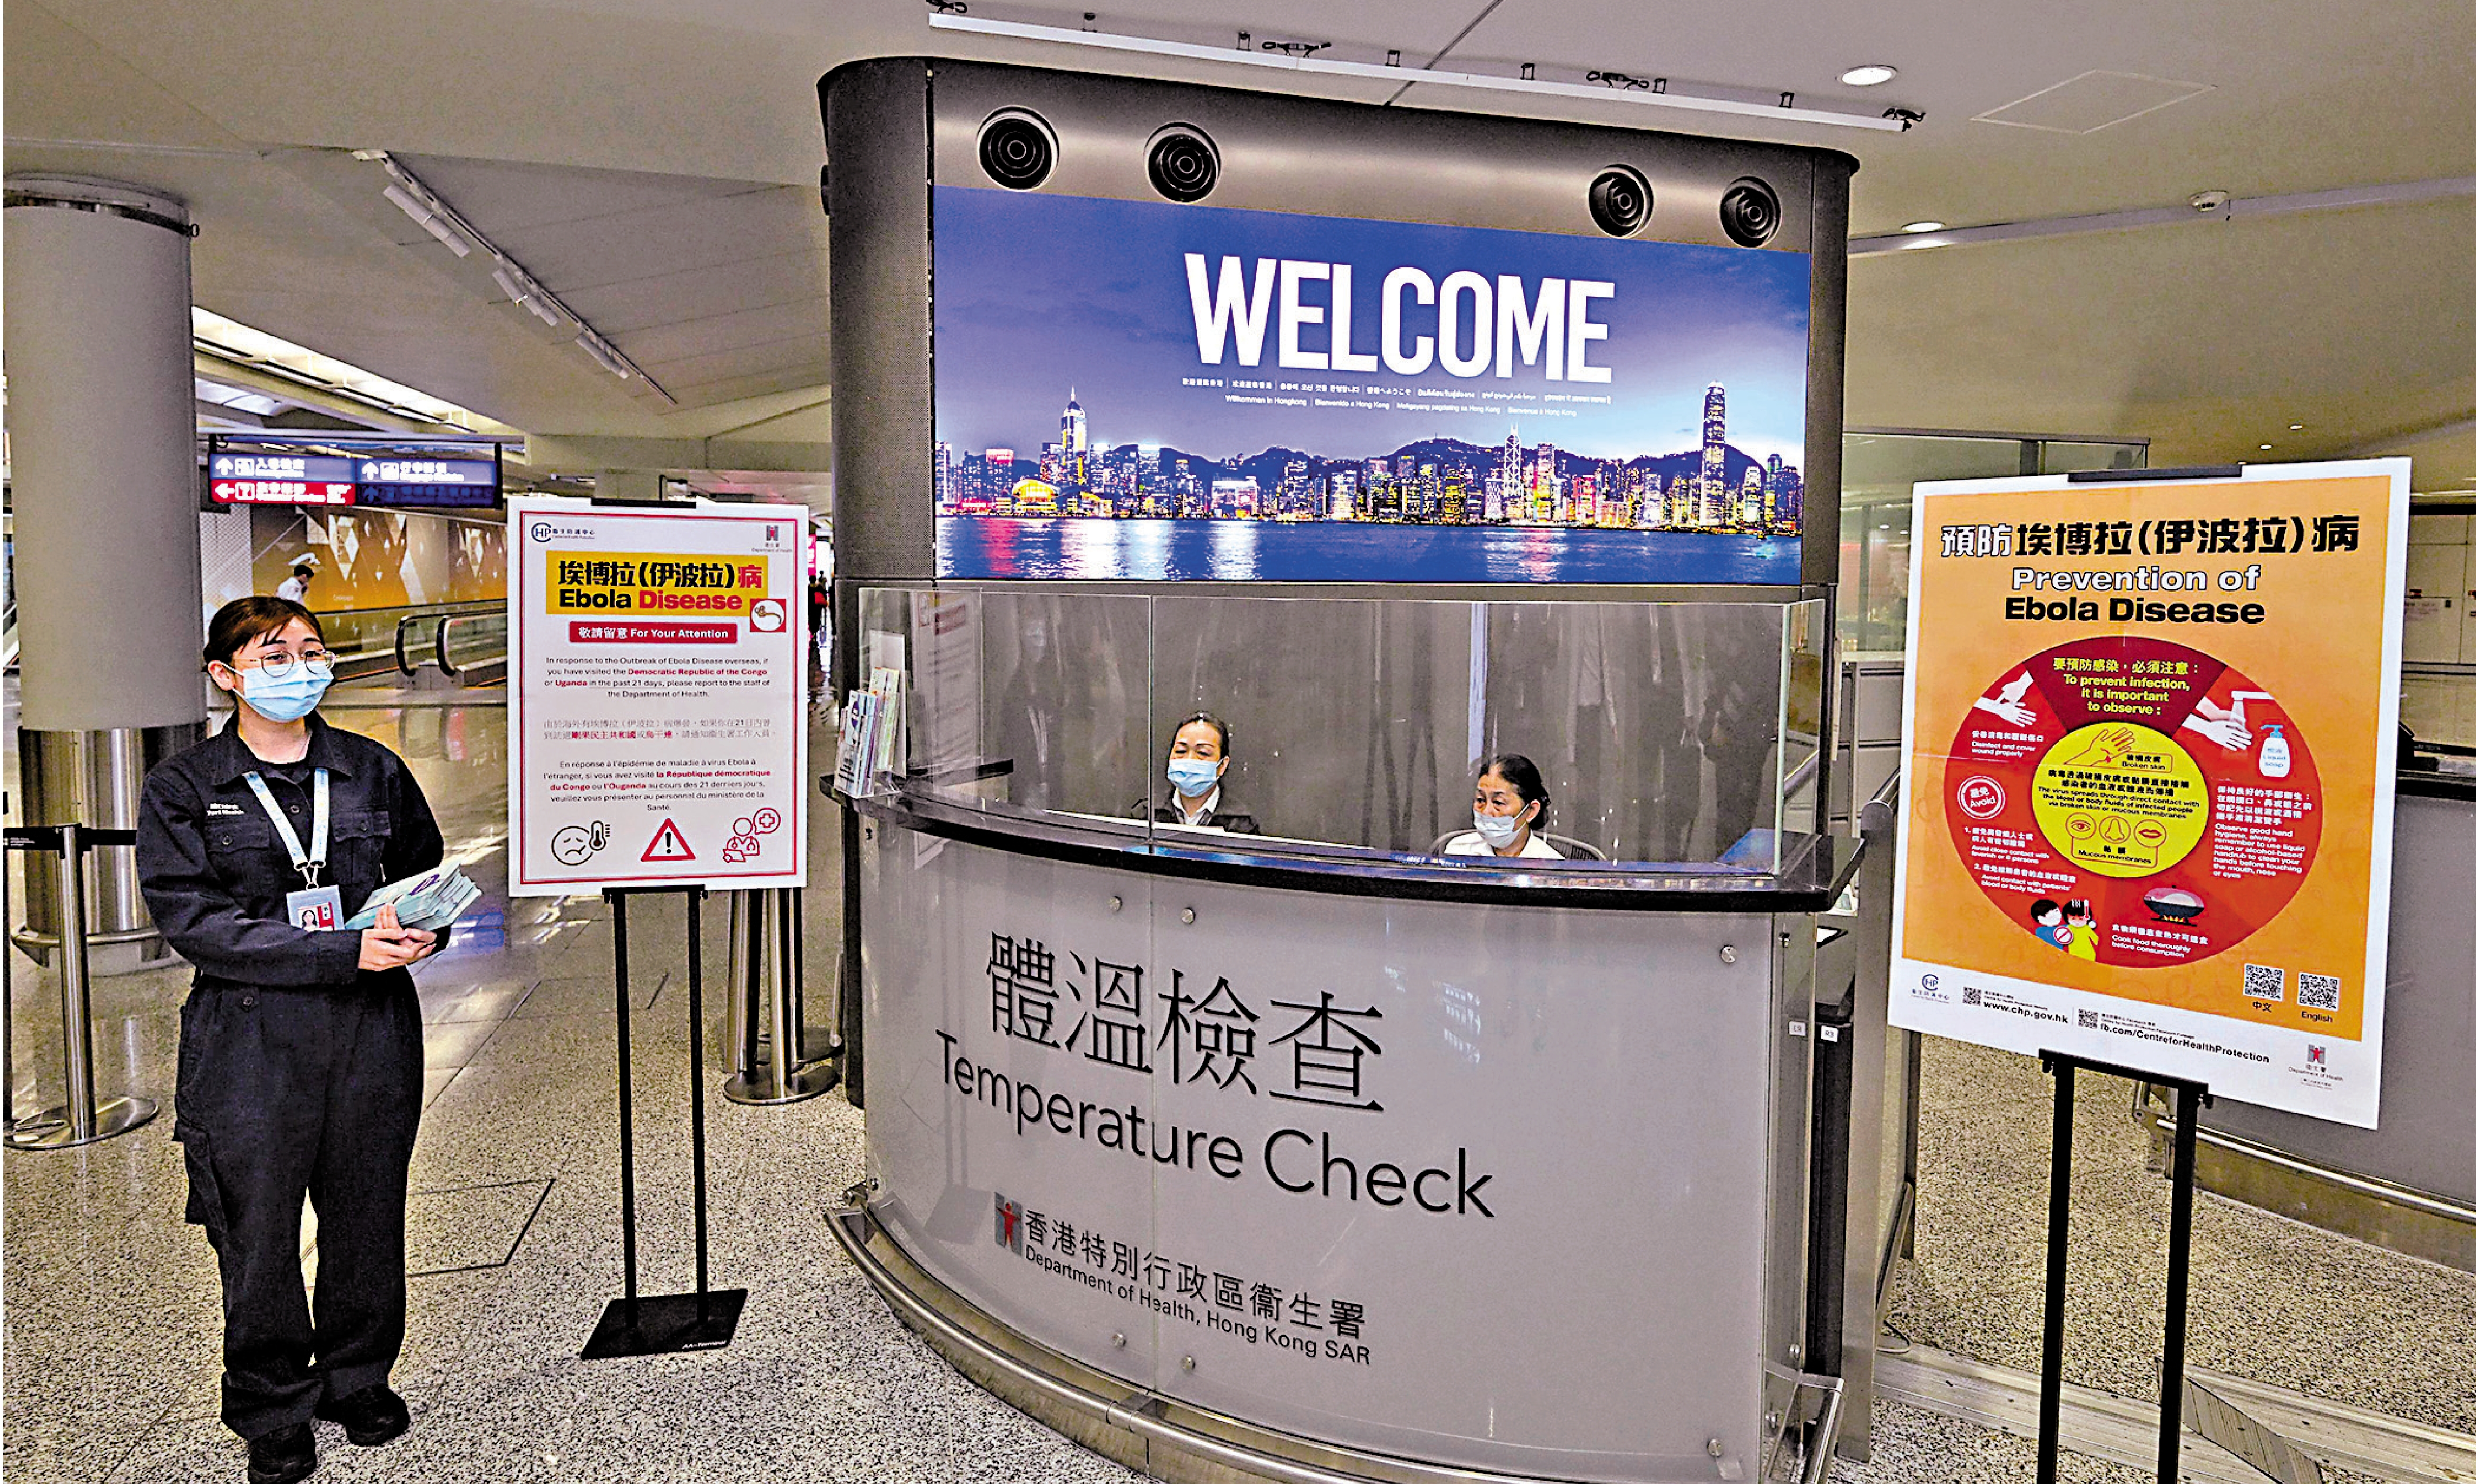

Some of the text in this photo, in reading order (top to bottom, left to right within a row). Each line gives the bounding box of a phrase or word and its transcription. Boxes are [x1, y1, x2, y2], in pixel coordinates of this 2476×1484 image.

[1184, 253, 1615, 383] WELCOME
[1940, 514, 2360, 558] 預防埃博拉(伊波拉)病
[557, 559, 762, 589] 埃博拉(伊波拉)病
[2012, 564, 2261, 591] Prevention of
[559, 589, 743, 610] Ebola Disease
[2004, 597, 2265, 624] Ebola Disease
[631, 628, 728, 638] For Your Attention
[2064, 674, 2190, 691] To prevent infection,
[2081, 688, 2169, 701] it is important
[2088, 701, 2100, 711] to
[1983, 1002, 2068, 1024] www.chp.gov.hk
[2252, 1000, 2272, 1012] 中文
[2301, 1011, 2333, 1023] English
[986, 931, 1384, 1112] 體溫檢查
[2100, 1023, 2269, 1063] fb.com/CentreforHealthProtection
[935, 1029, 1495, 1218] Temperature Check
[1026, 1244, 1371, 1364] Department of Health, Hong Kong SAR
